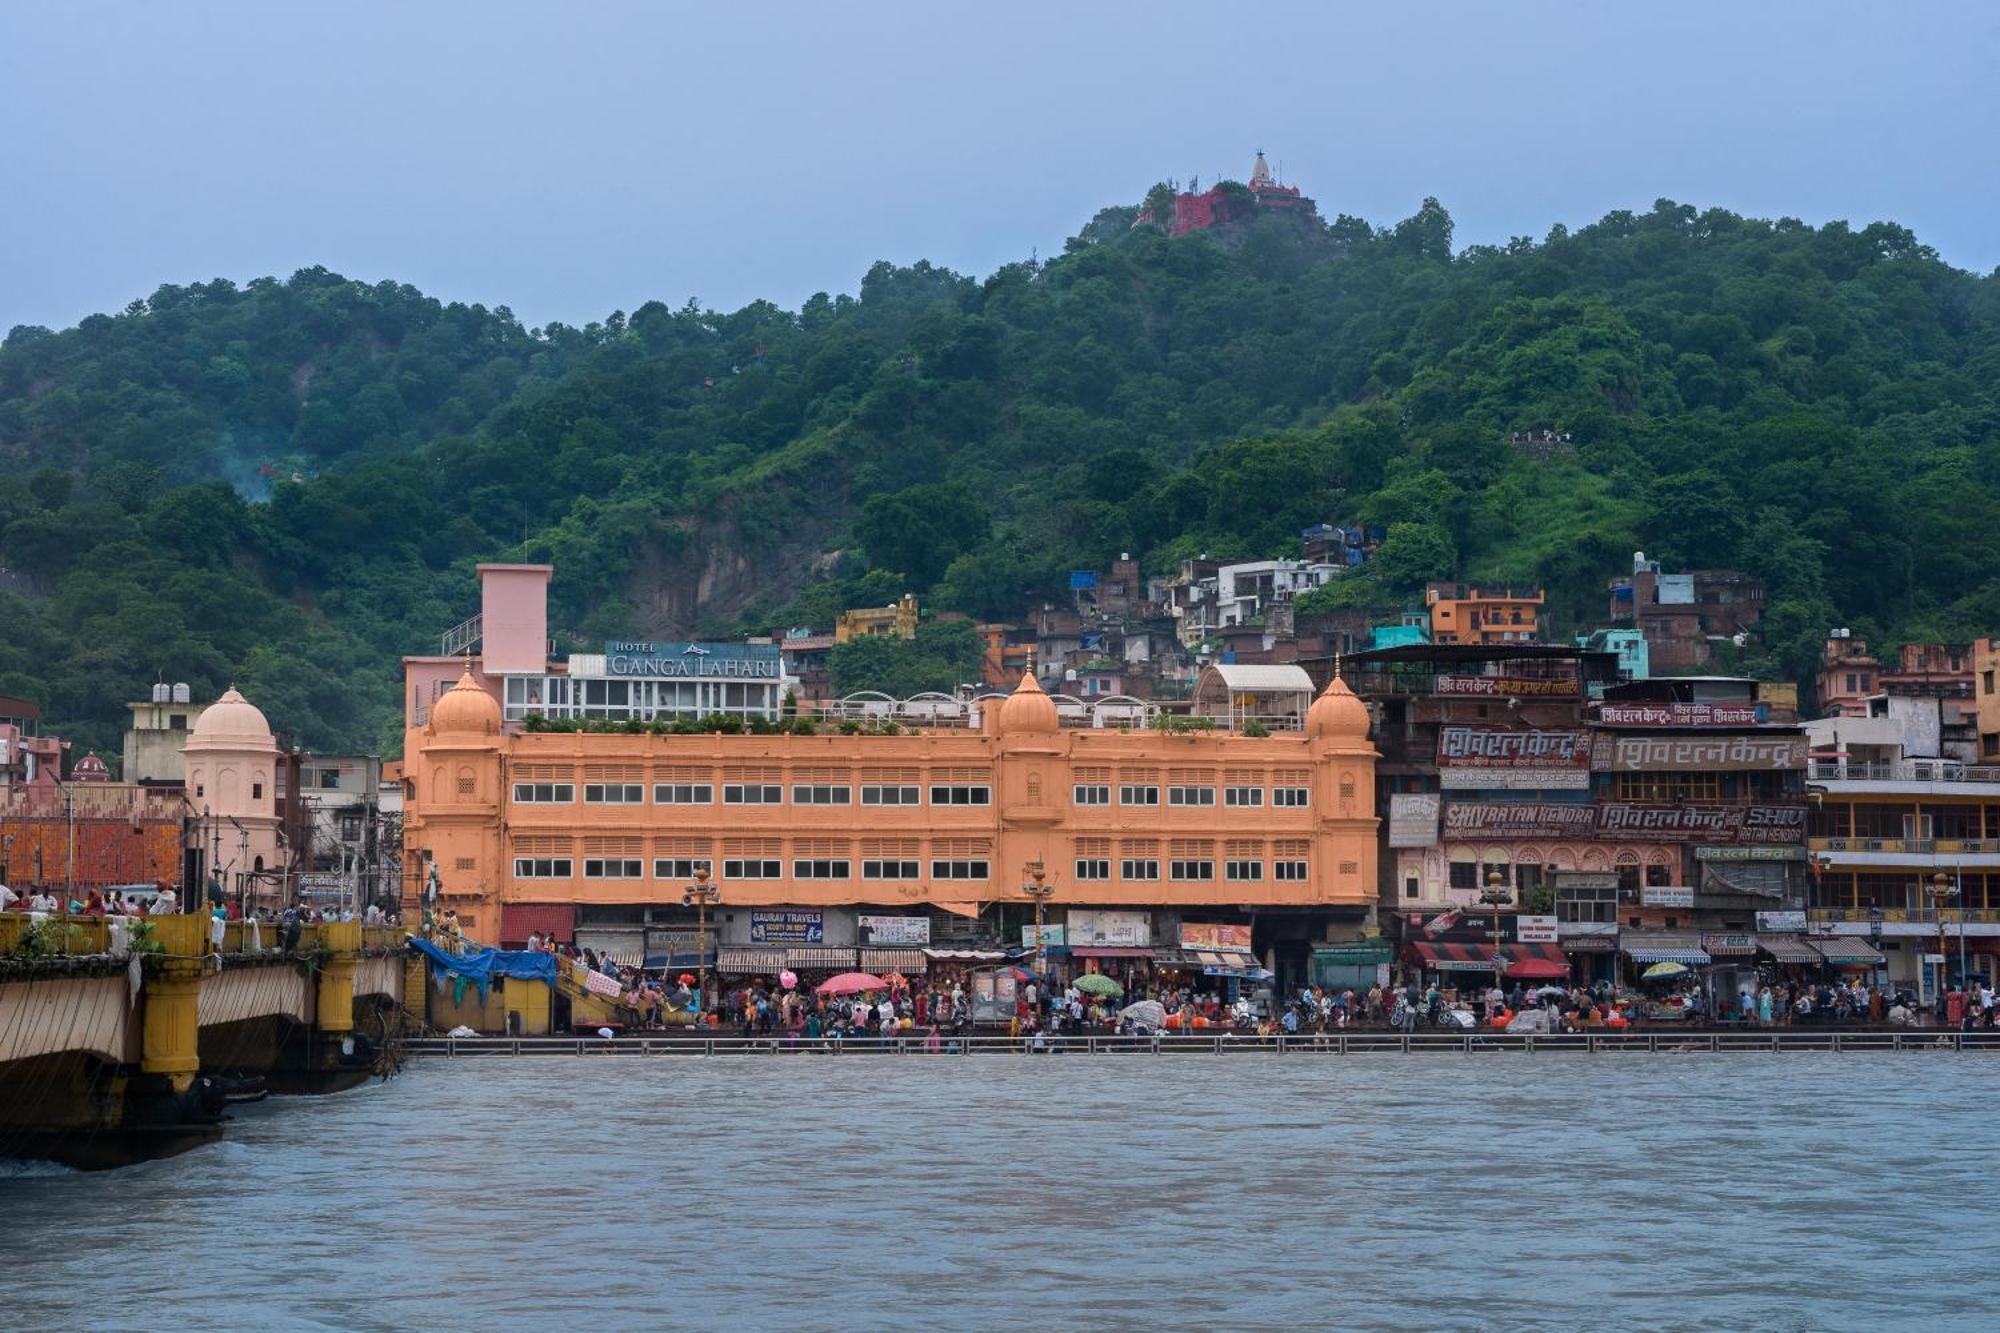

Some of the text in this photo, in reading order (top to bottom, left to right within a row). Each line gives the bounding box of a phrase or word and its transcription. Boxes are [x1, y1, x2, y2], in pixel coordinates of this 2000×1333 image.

[616, 642, 656, 652] HOTEL
[611, 655, 776, 677] GANGA LAHARI
[1601, 708, 1622, 723] शिव
[1442, 727, 1487, 757] शिव
[1487, 732, 1528, 756] रत्न
[1528, 729, 1577, 759] केन्द्र
[1616, 737, 1670, 769] शिव
[1674, 741, 1728, 763] रत्न
[1730, 737, 1793, 768] केन्द्र
[1447, 804, 1595, 828] SHIV RATAN KENDRA
[1602, 806, 1643, 830] शिव
[1643, 809, 1682, 828] रत्न
[1747, 807, 1804, 825] SHIV
[1739, 827, 1767, 842] RATAN
[1767, 827, 1801, 842] KENDRA
[752, 912, 822, 924] GAURAV TRAVELS
